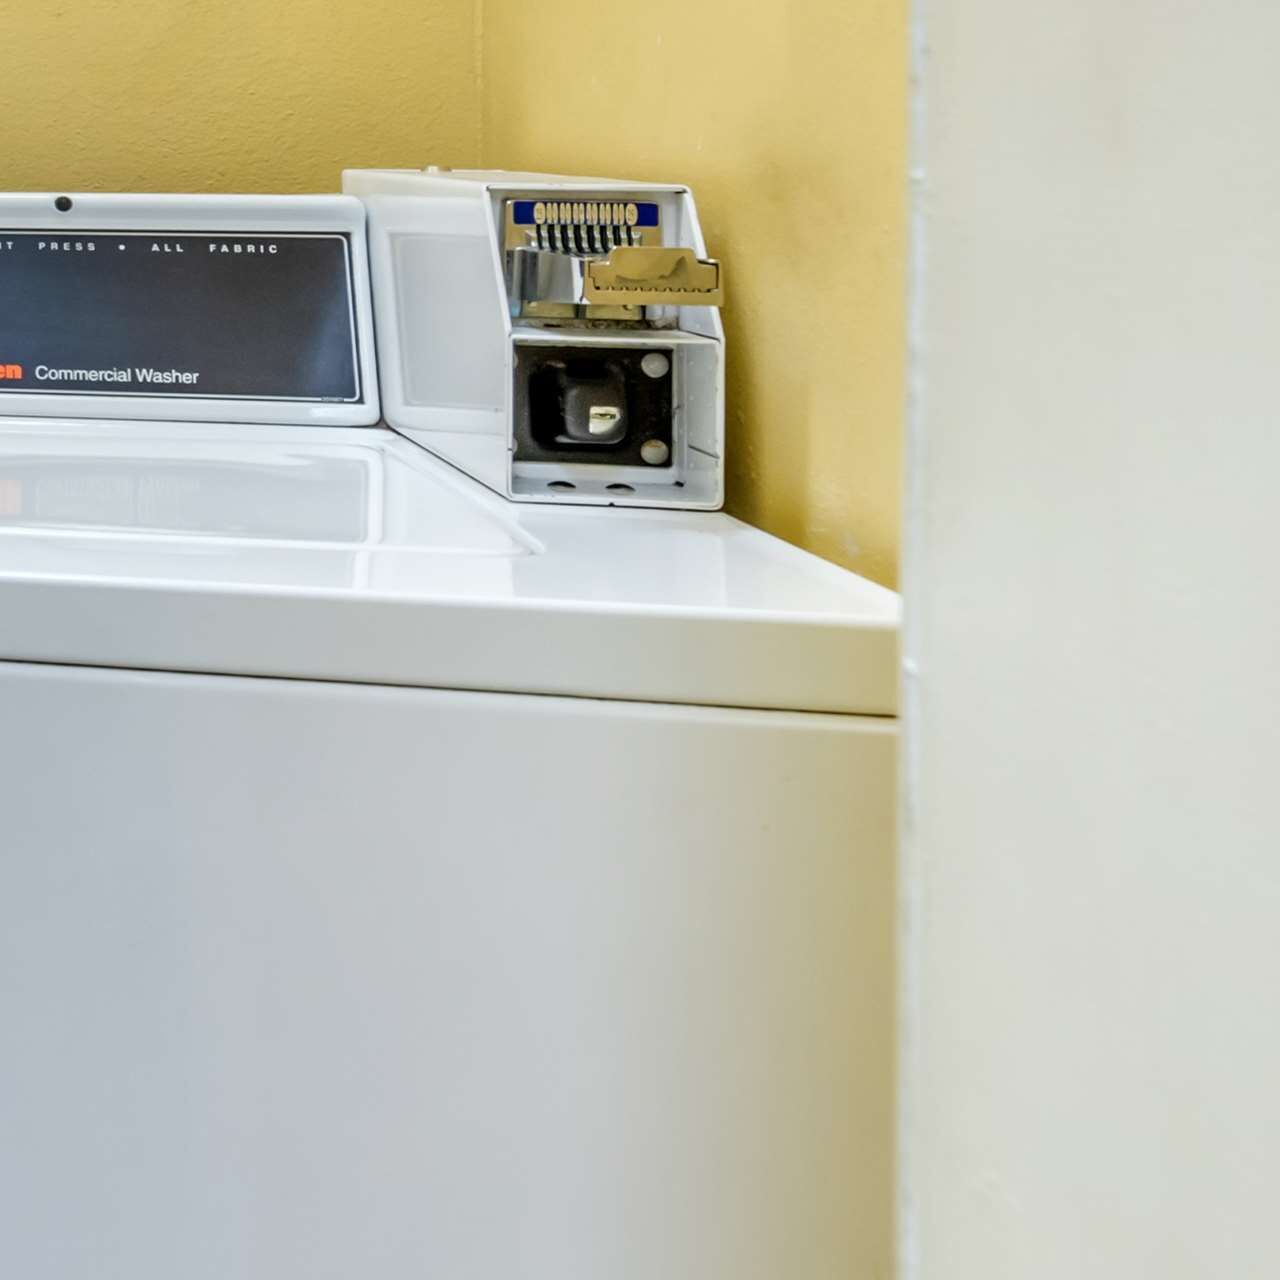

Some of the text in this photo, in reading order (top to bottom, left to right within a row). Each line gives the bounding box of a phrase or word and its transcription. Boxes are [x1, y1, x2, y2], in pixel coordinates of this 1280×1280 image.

[38, 242, 97, 252] PRESS
[151, 243, 185, 253] ALL
[209, 244, 279, 254] FABRIC
[35, 365, 132, 384] Commercial
[135, 368, 199, 386] Washer
